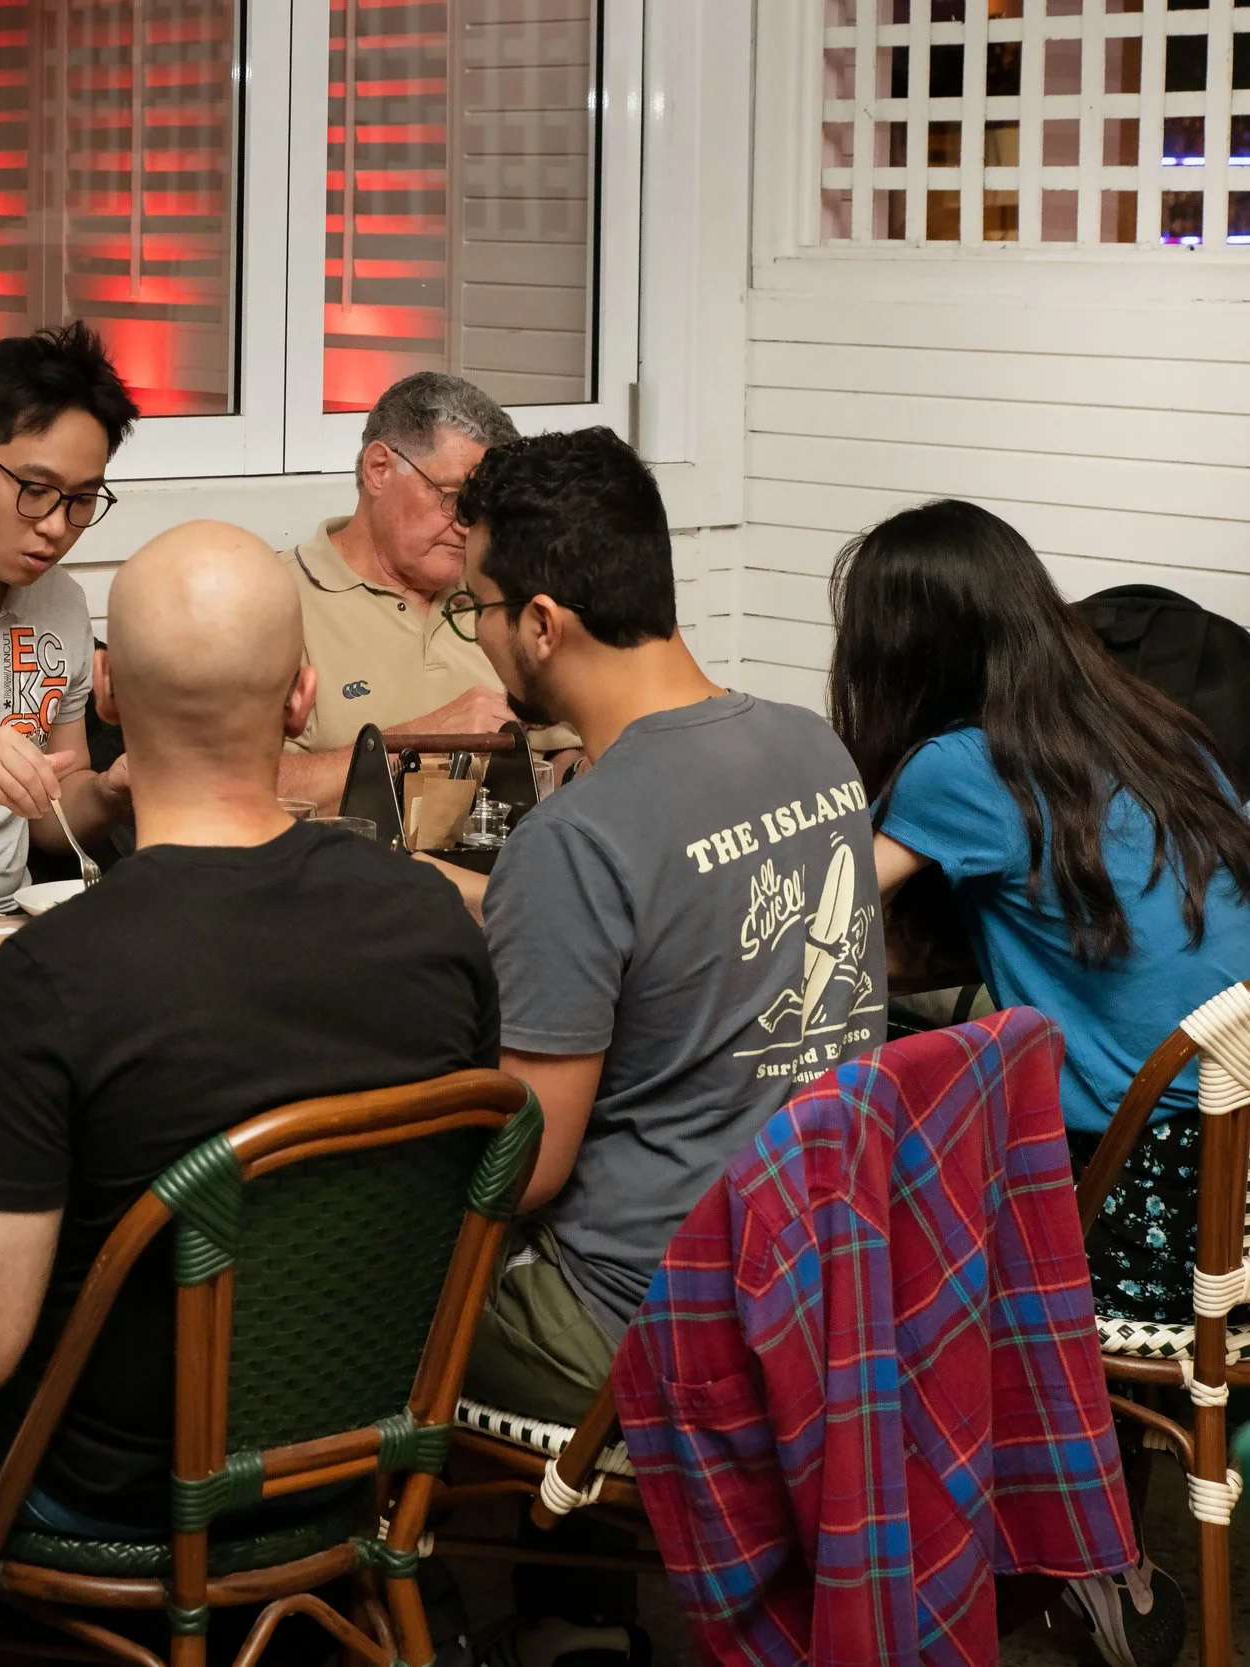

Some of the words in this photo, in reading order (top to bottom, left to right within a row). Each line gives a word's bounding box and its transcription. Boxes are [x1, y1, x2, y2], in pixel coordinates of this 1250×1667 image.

[686, 821, 759, 873] THE
[761, 780, 868, 844] ISLAND
[741, 864, 805, 961] Swell
[749, 858, 782, 931] All
